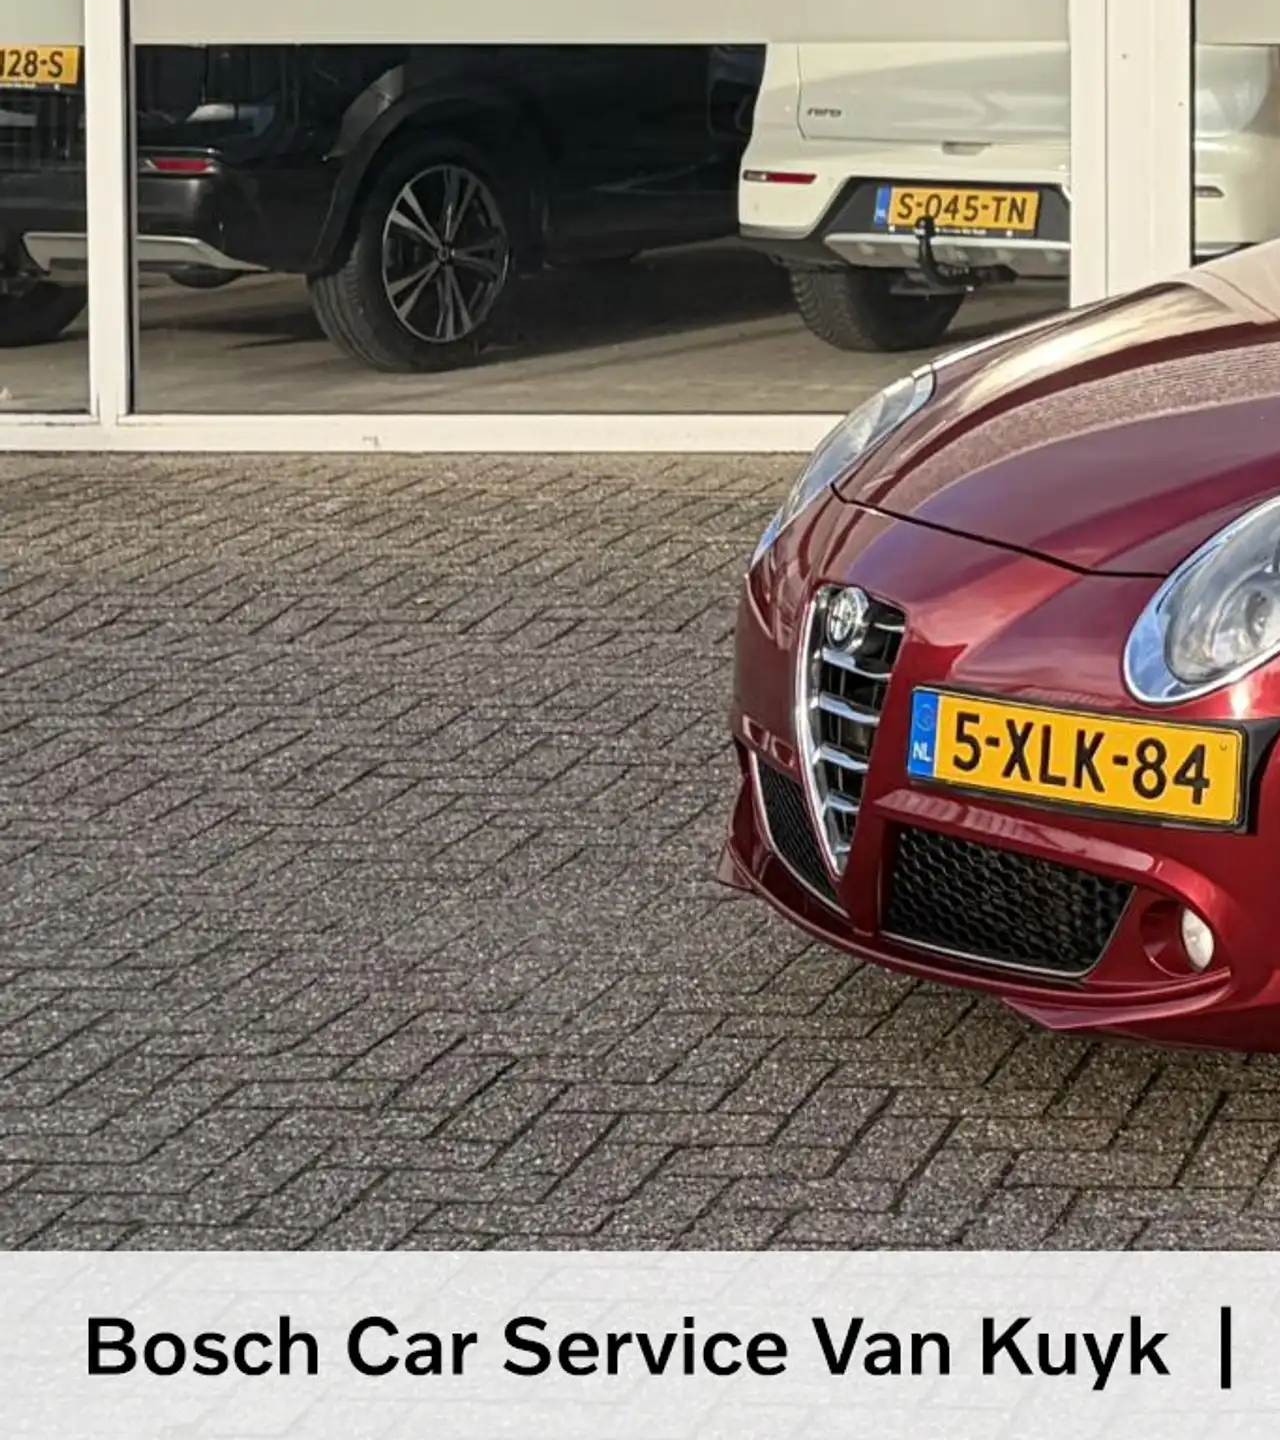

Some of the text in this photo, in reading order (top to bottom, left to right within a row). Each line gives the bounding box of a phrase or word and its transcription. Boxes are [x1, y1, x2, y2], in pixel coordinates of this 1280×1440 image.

[897, 193, 1026, 224] S-045-TN
[912, 741, 932, 762] NL
[952, 712, 1211, 805] 5-XLK-84
